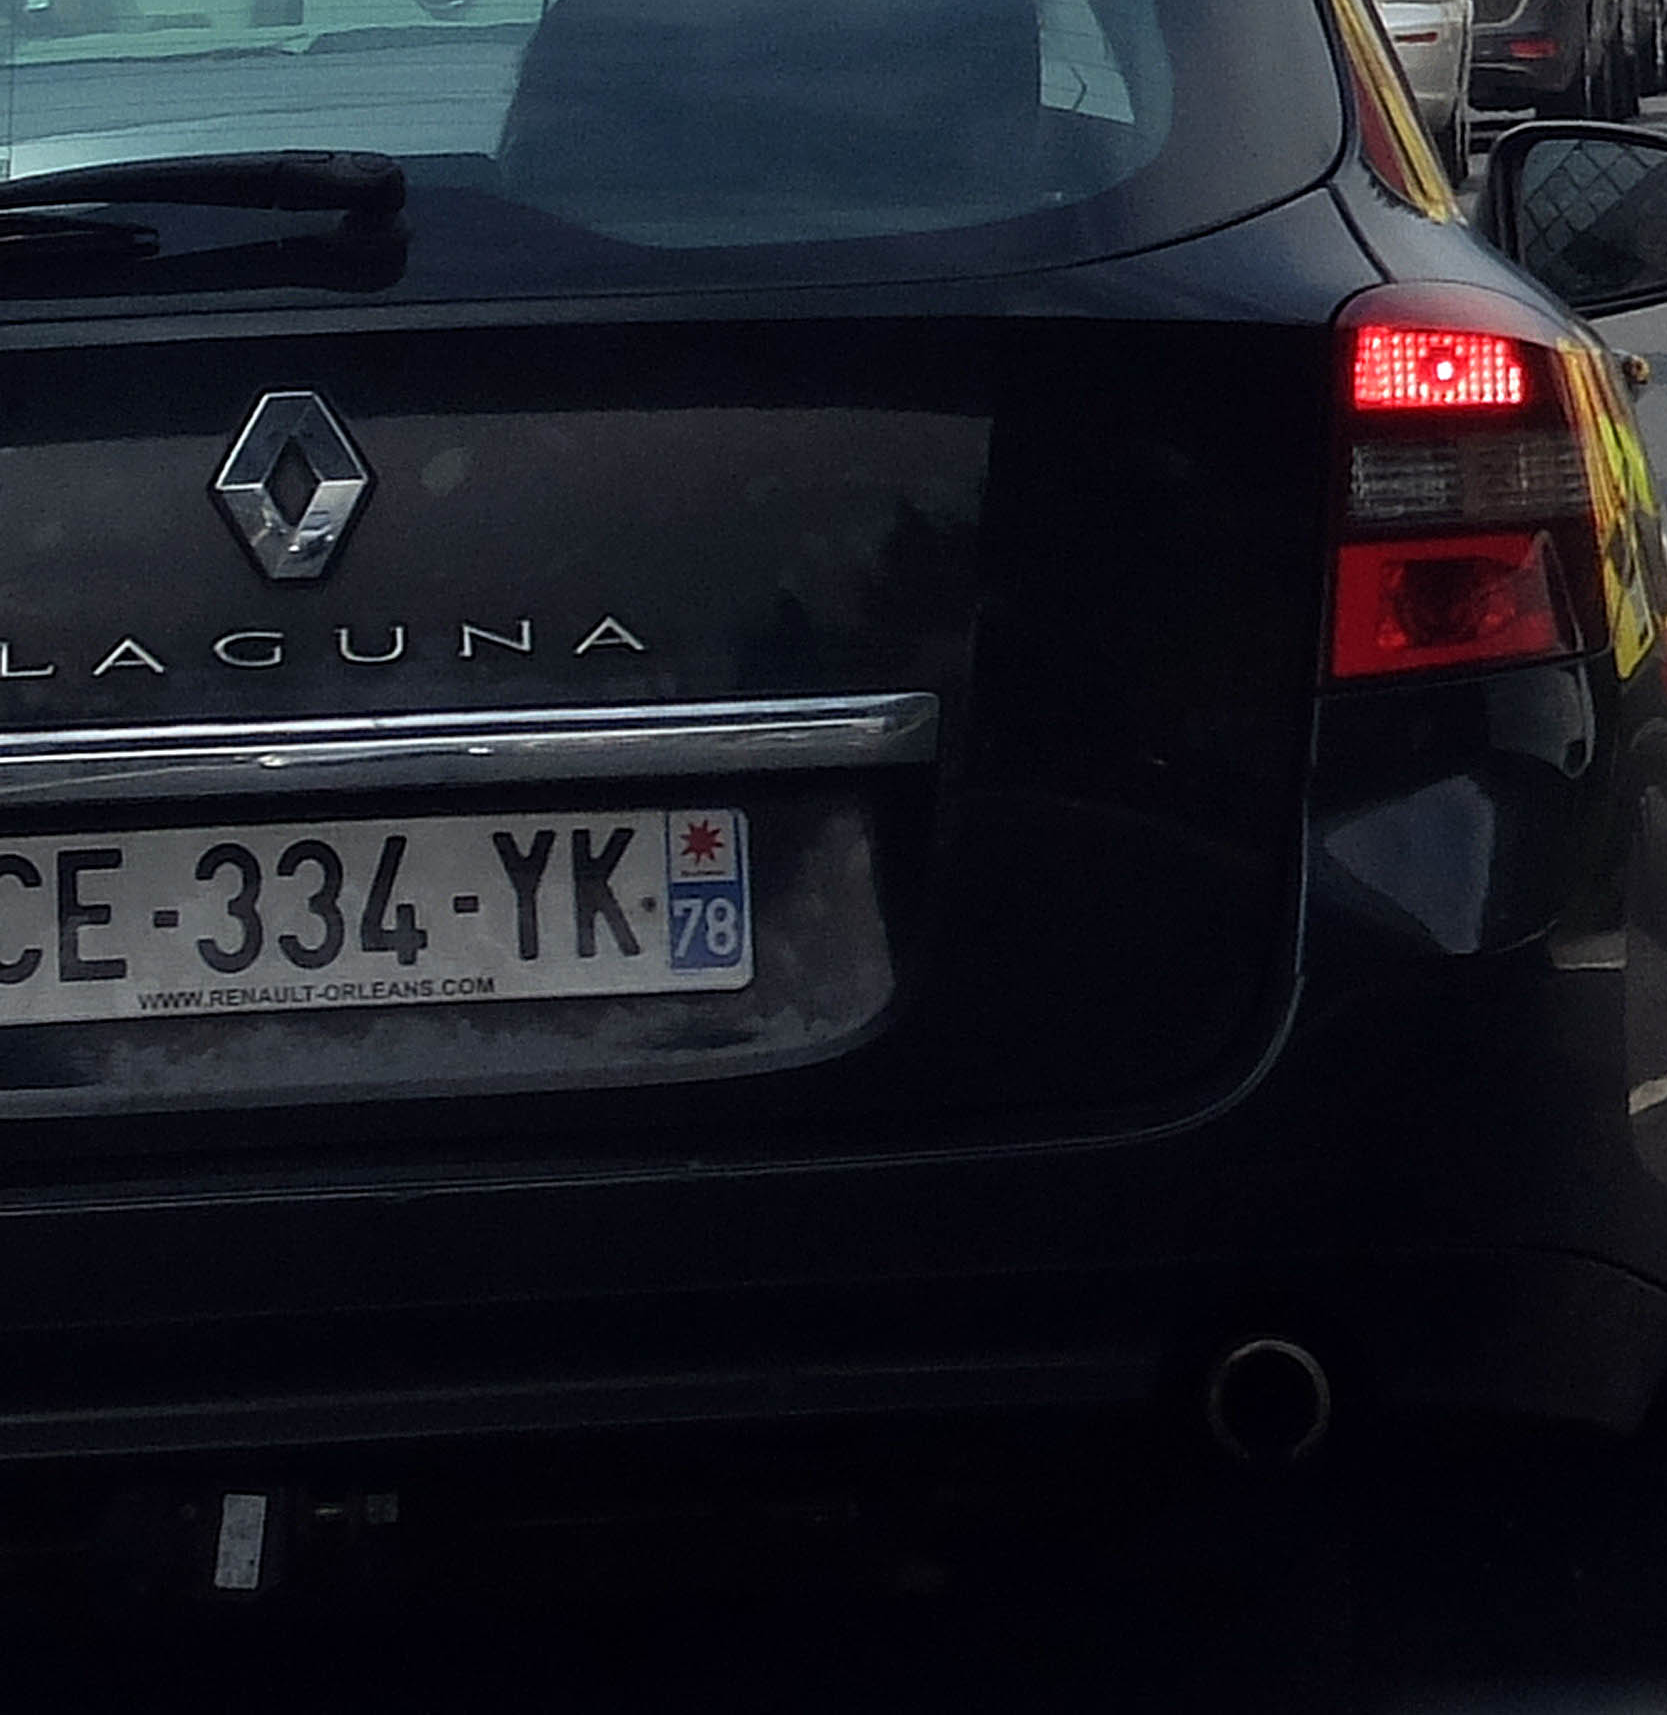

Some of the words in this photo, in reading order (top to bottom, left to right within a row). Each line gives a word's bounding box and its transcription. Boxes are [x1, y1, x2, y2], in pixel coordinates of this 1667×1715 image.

[0, 616, 645, 679] LAGUNA
[672, 897, 738, 958] 78
[137, 977, 495, 1010] WWW.RENAULT-ORLEANS.COM
